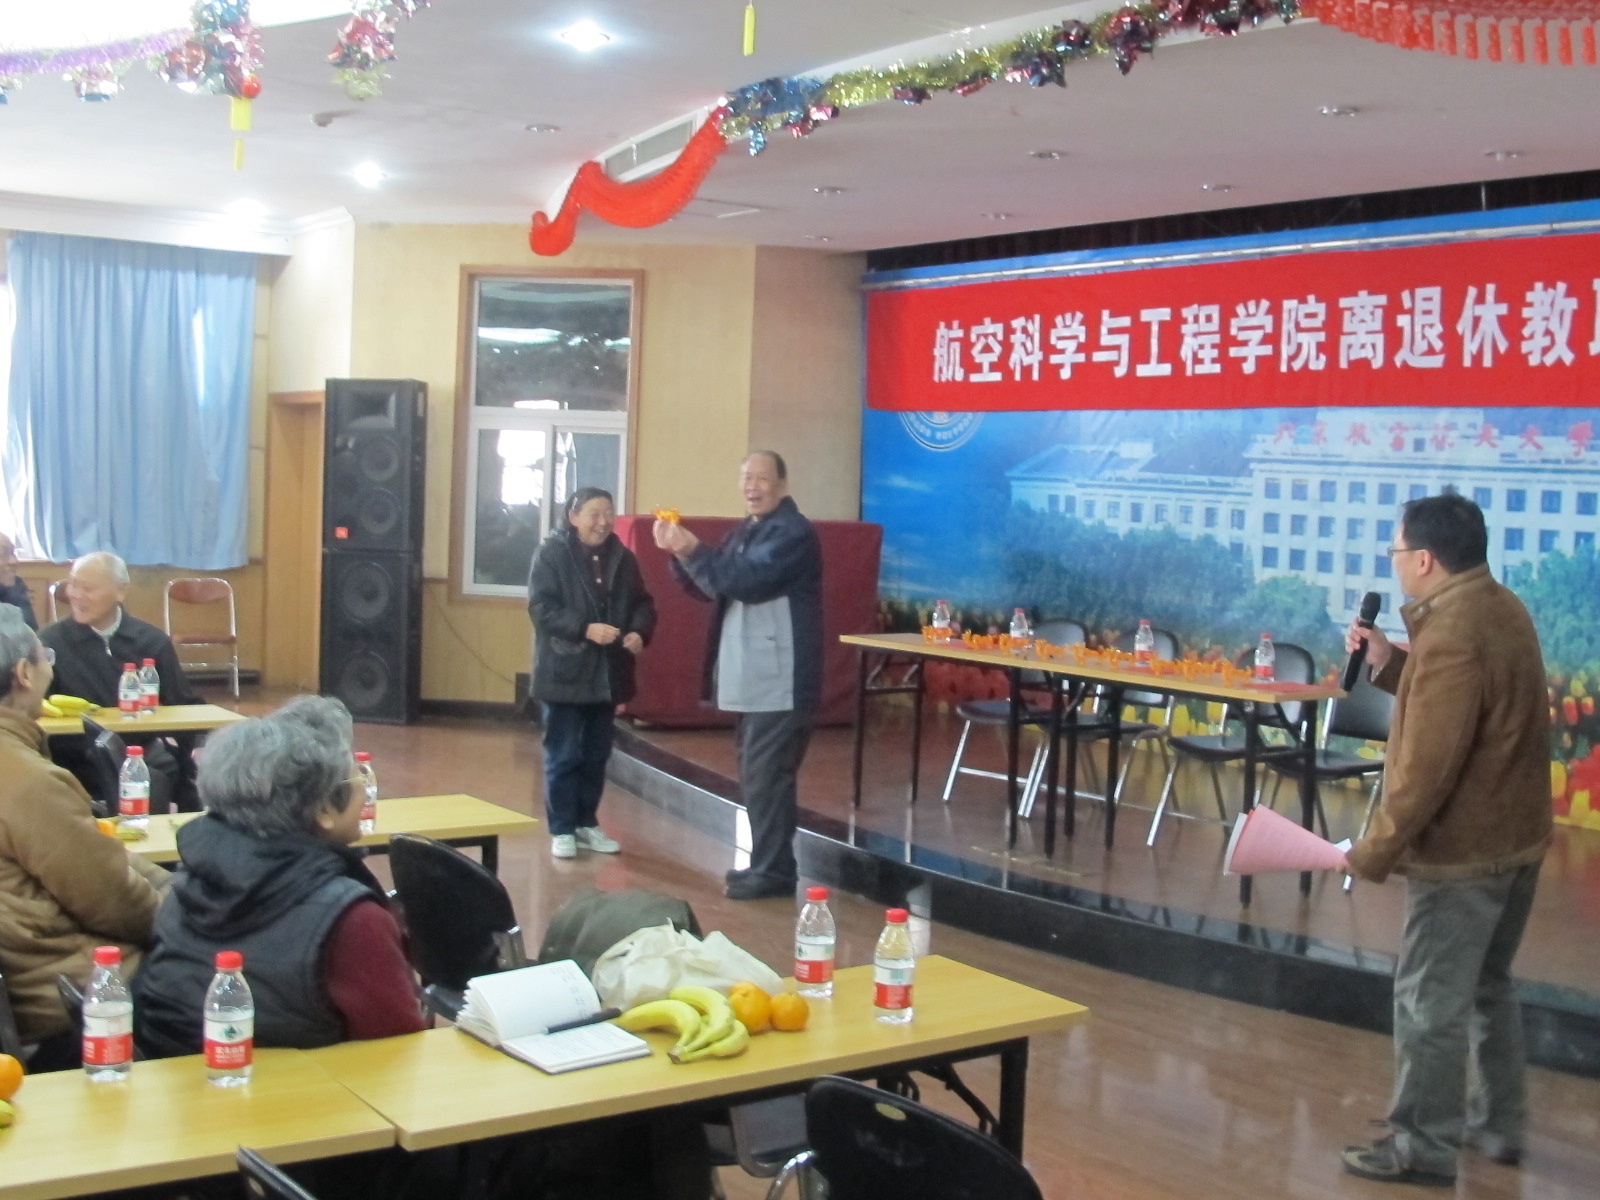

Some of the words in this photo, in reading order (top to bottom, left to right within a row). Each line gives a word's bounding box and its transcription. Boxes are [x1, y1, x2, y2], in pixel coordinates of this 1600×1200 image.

[932, 278, 1600, 383] 航空科学与工程学院离退休教
